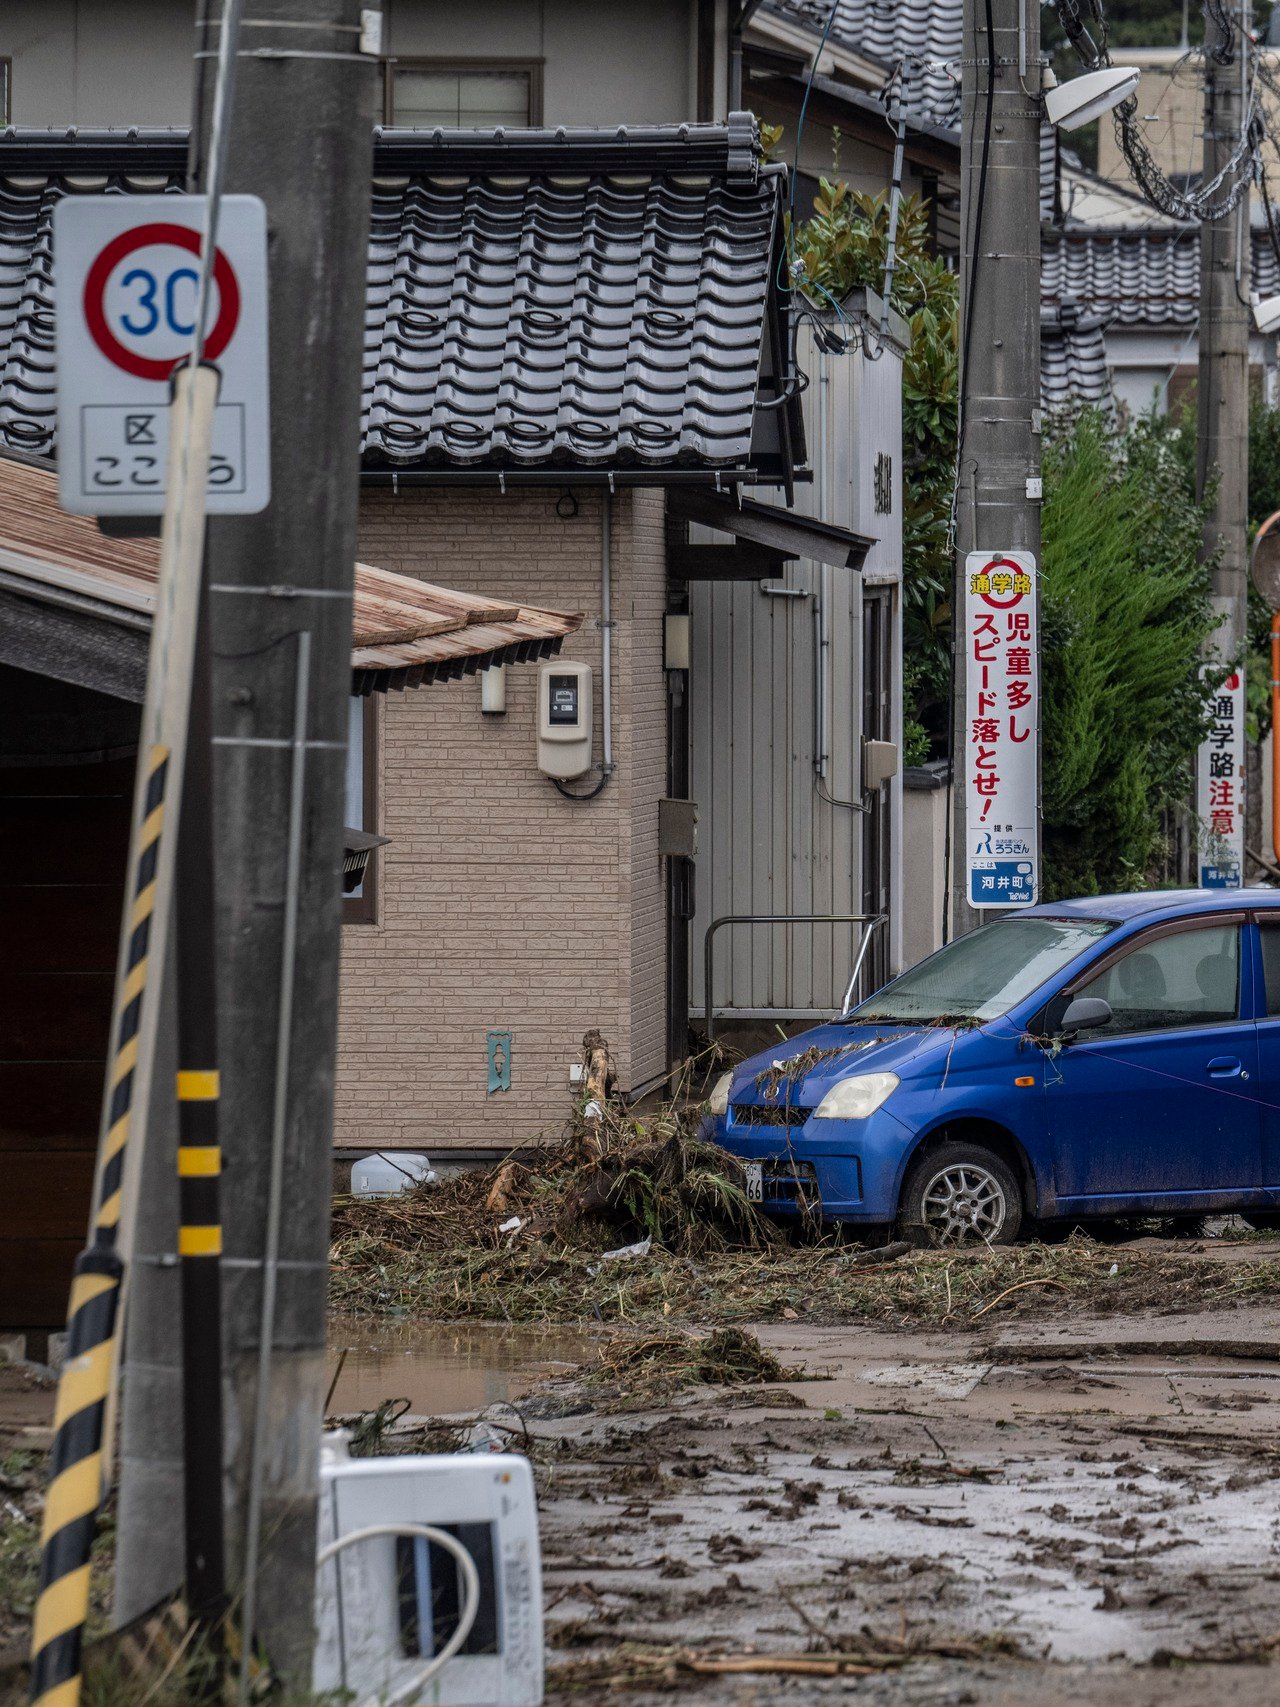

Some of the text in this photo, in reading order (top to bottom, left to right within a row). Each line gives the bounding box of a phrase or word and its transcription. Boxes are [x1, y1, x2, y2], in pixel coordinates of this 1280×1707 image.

[120, 268, 201, 336] 30
[94, 455, 235, 487] ここら
[970, 572, 1032, 596] 通学路
[1005, 612, 1032, 743] 児童多し
[972, 613, 1001, 822] スピード落とせ!
[1207, 695, 1235, 834] 通学路注意
[994, 825, 1013, 833] 提供
[995, 844, 1030, 855] ろうきん
[981, 876, 1024, 890] 河井町
